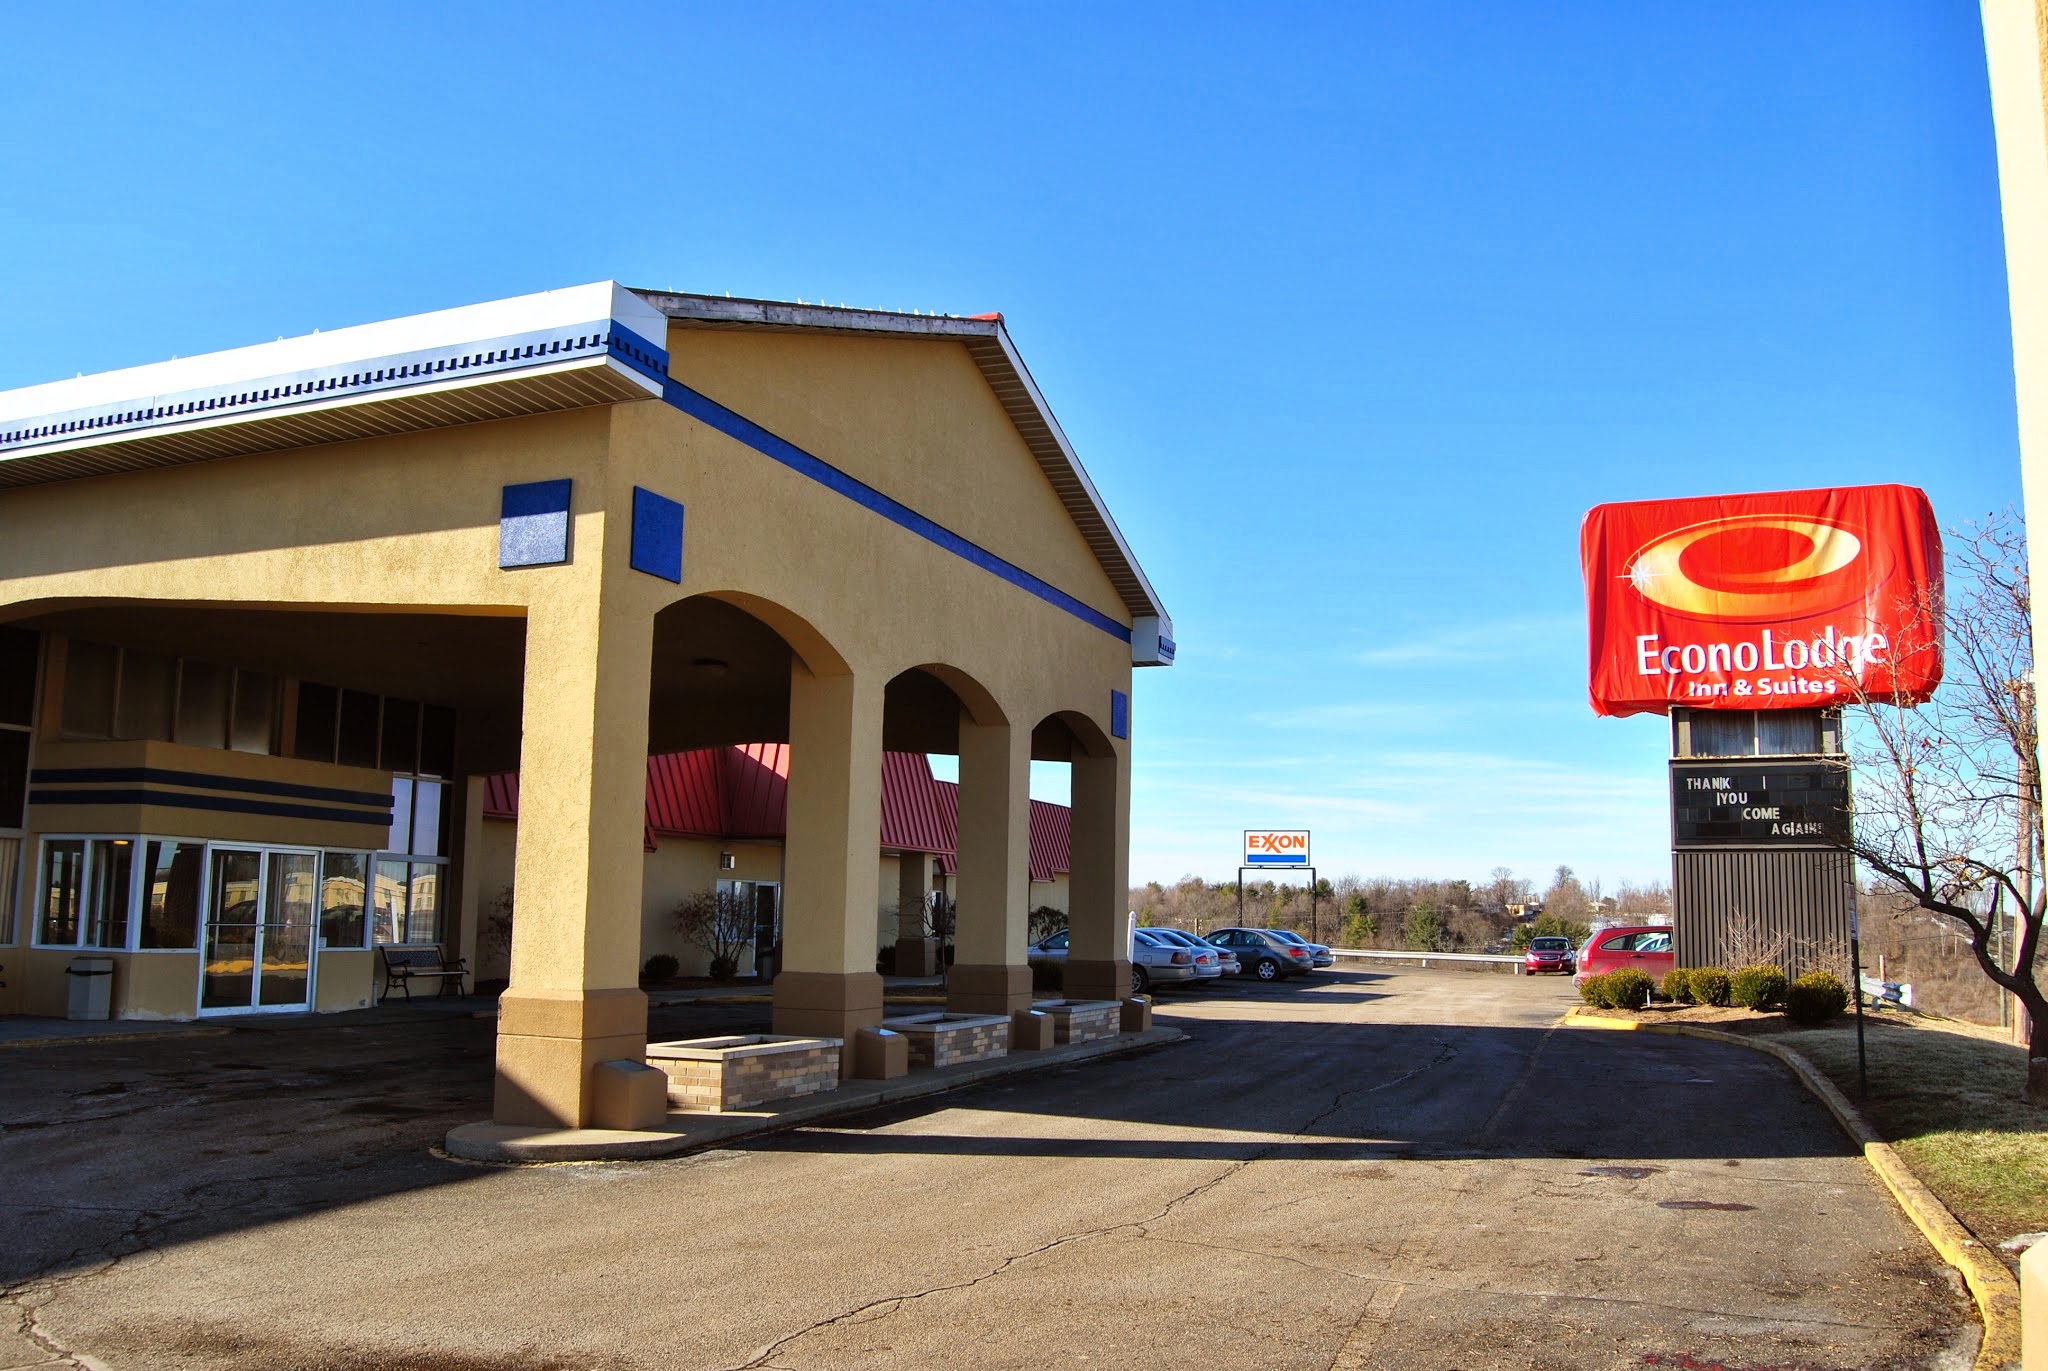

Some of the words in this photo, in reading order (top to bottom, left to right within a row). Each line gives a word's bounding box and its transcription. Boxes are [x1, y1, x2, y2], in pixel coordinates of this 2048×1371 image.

[1689, 681, 1728, 697] Inn
[1733, 678, 1752, 696] &
[1757, 675, 1837, 696] Suites
[1686, 777, 1731, 790] THANK
[1719, 792, 1748, 805] YOU
[1742, 807, 1780, 820] COME
[1248, 833, 1305, 854] EXXON
